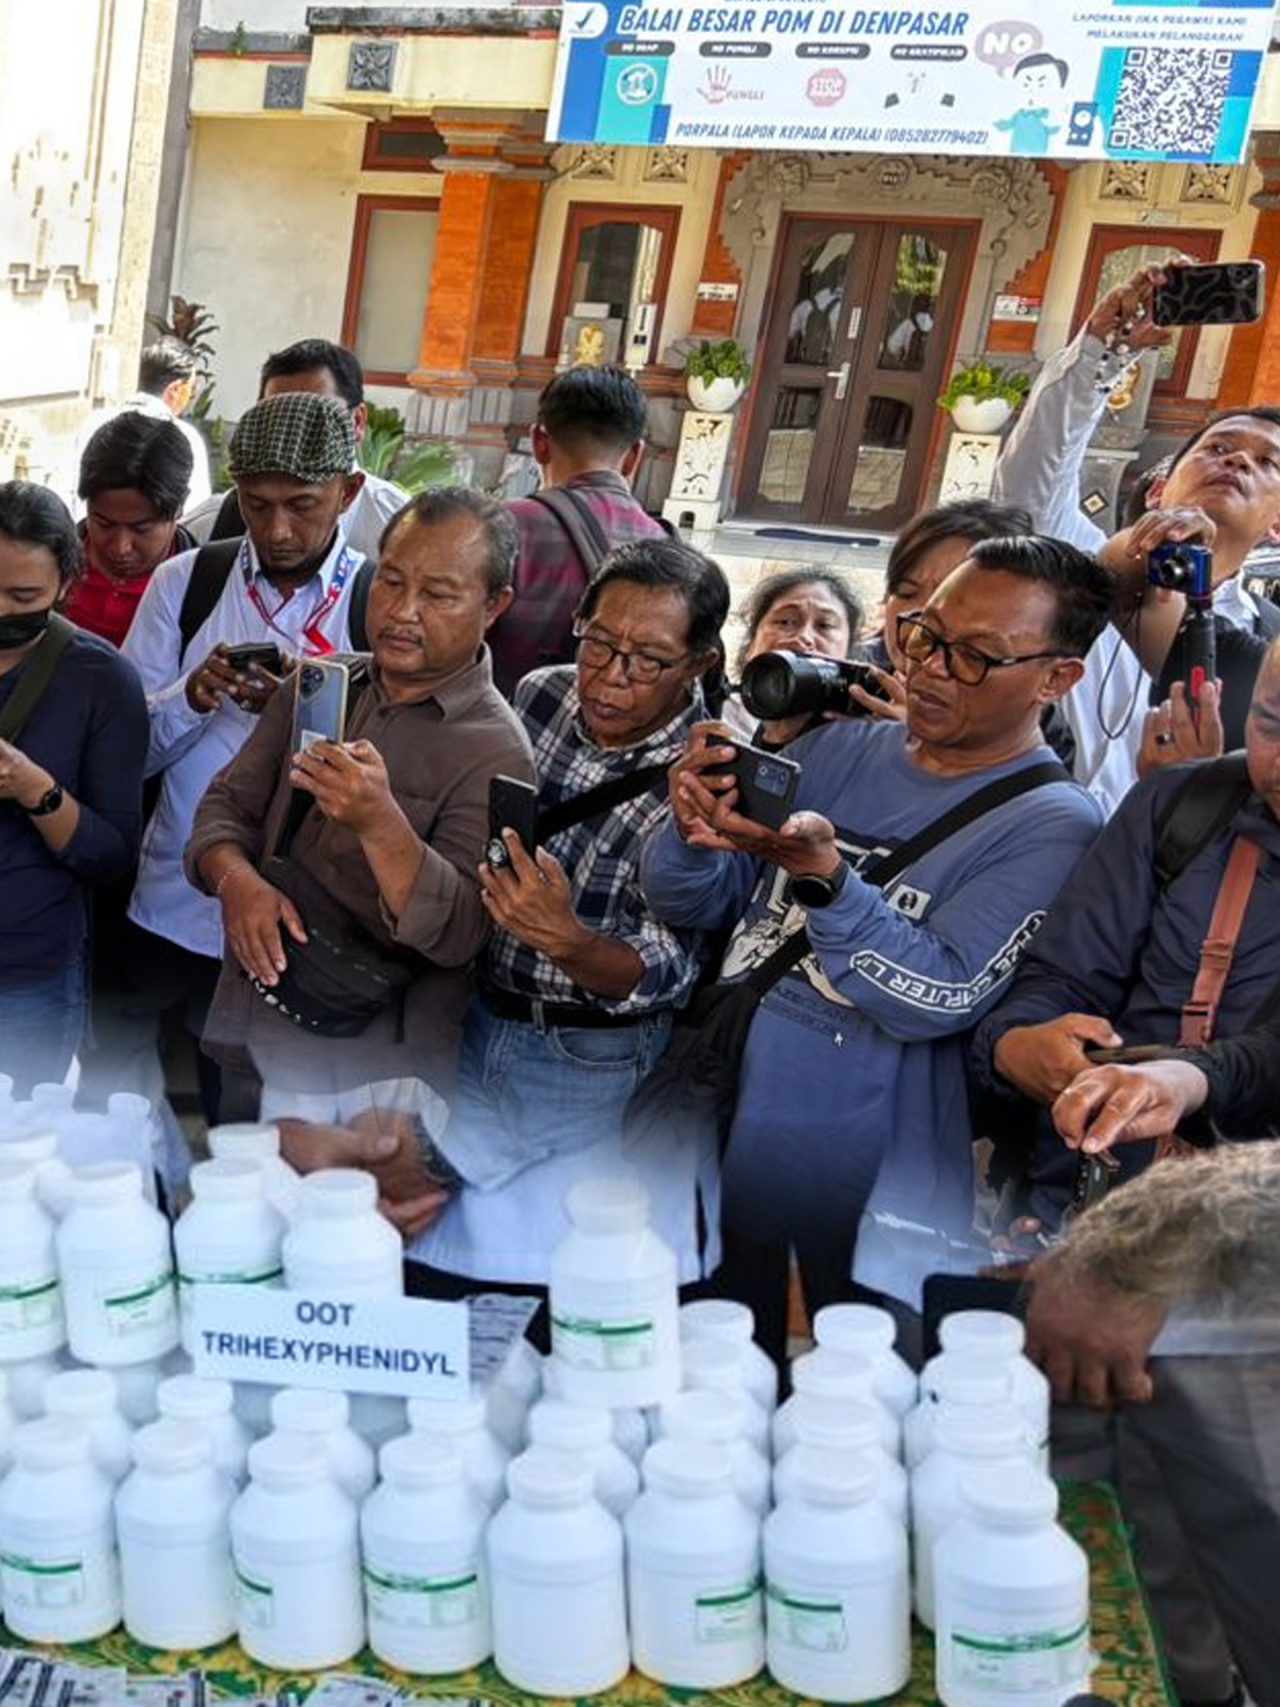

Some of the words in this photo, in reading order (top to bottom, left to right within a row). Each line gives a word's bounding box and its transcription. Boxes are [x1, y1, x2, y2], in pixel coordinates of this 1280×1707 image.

[620, 8, 683, 32] BALAI
[687, 9, 756, 33] BESAR
[761, 9, 814, 33] POM
[818, 10, 845, 34] DI
[849, 10, 969, 36] DENPASAR
[982, 32, 1034, 55] NO
[676, 122, 729, 138] PORPALA
[779, 124, 827, 140] KEPADA
[295, 1300, 354, 1326] OOT
[201, 1330, 457, 1377] TRIHEXYPHENIDYL
